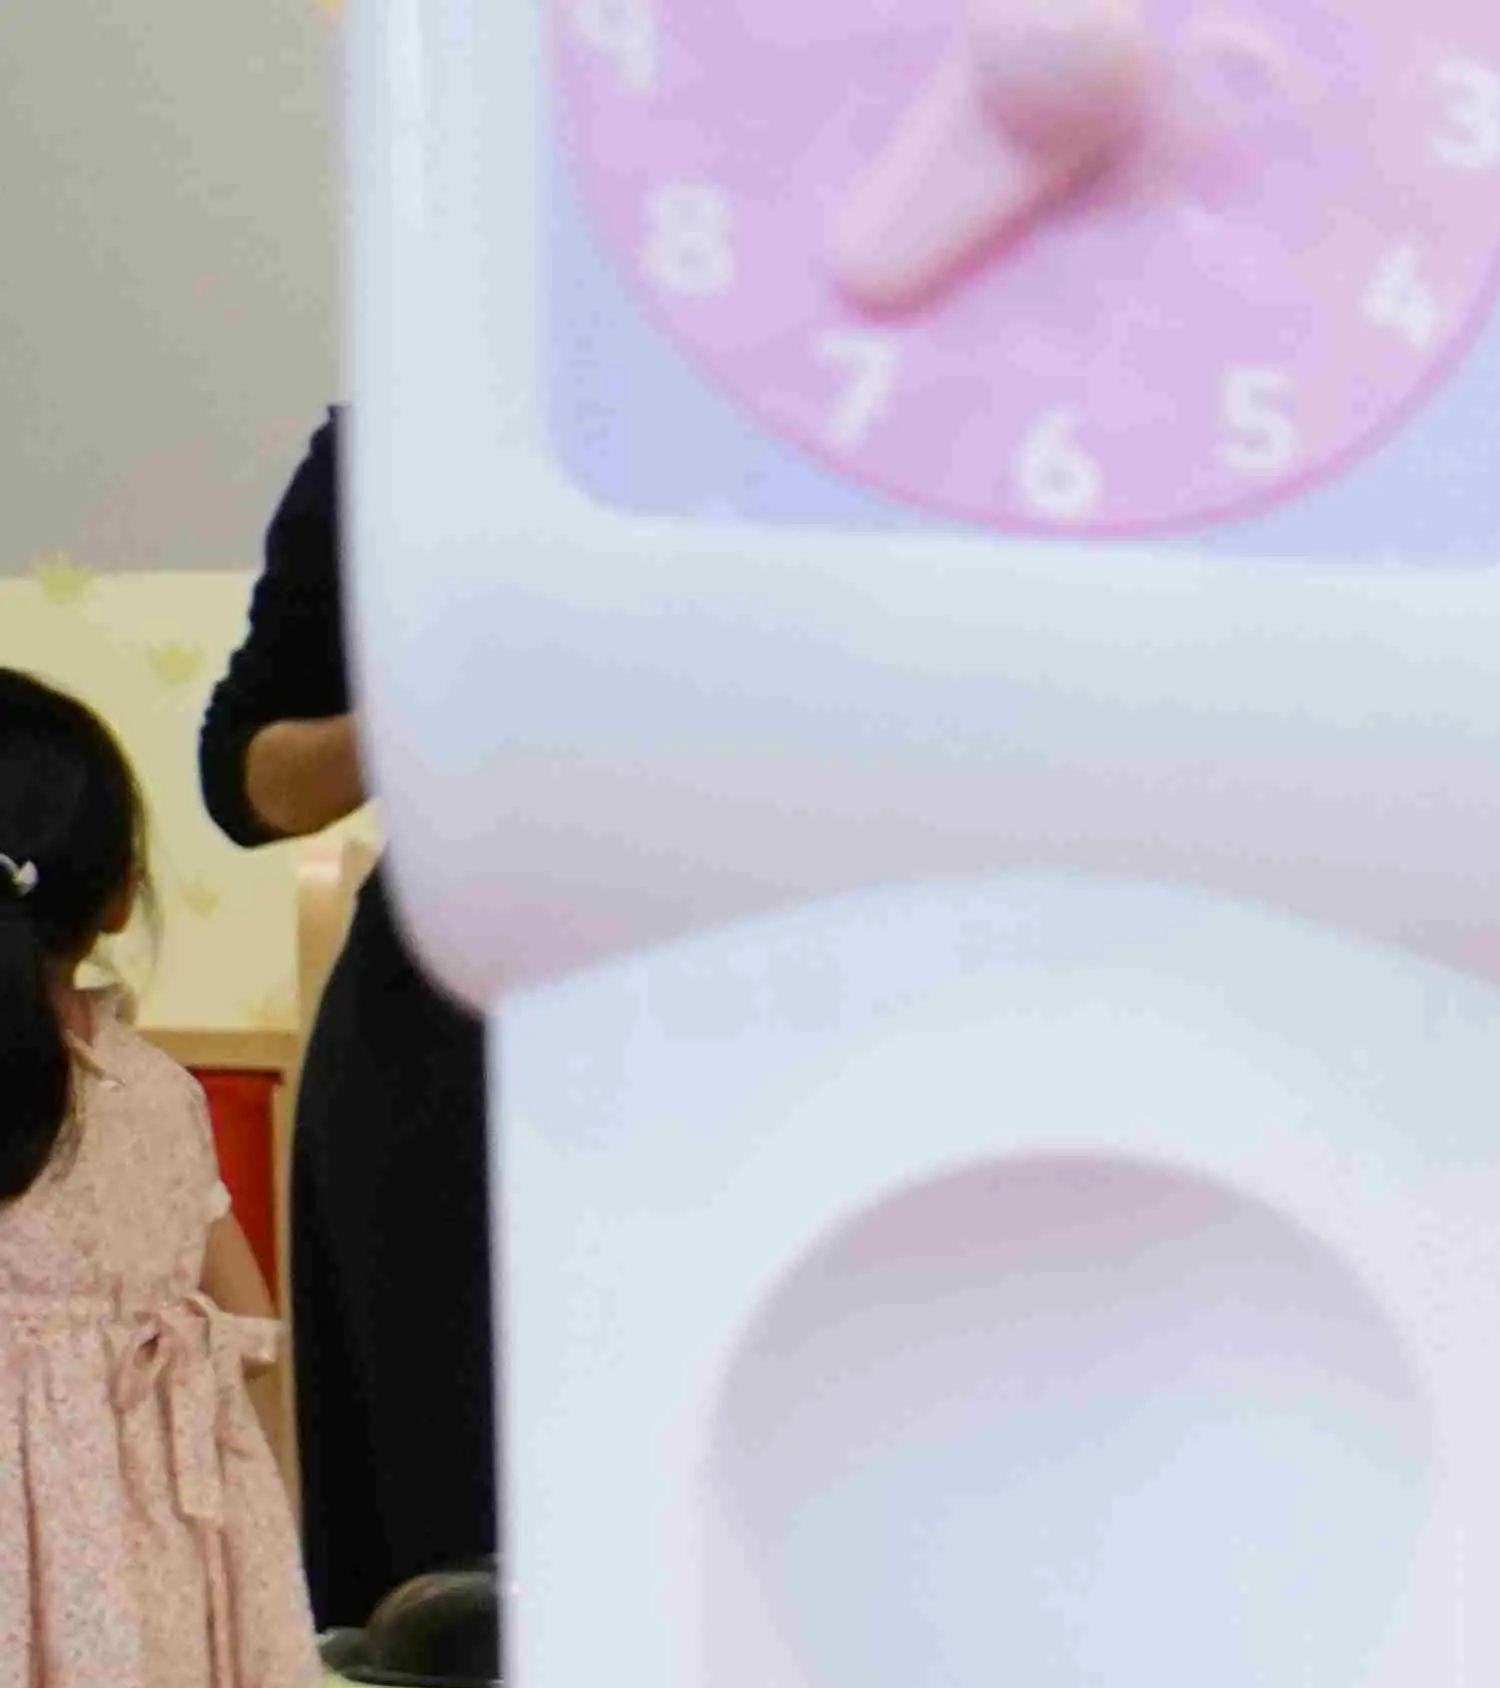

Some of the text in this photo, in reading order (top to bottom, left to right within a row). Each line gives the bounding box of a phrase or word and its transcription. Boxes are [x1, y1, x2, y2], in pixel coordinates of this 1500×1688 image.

[645, 184, 735, 298] 8
[1361, 247, 1444, 354] 4
[814, 332, 898, 448] 7
[1219, 364, 1302, 474] 5
[1012, 406, 1102, 520] 6
